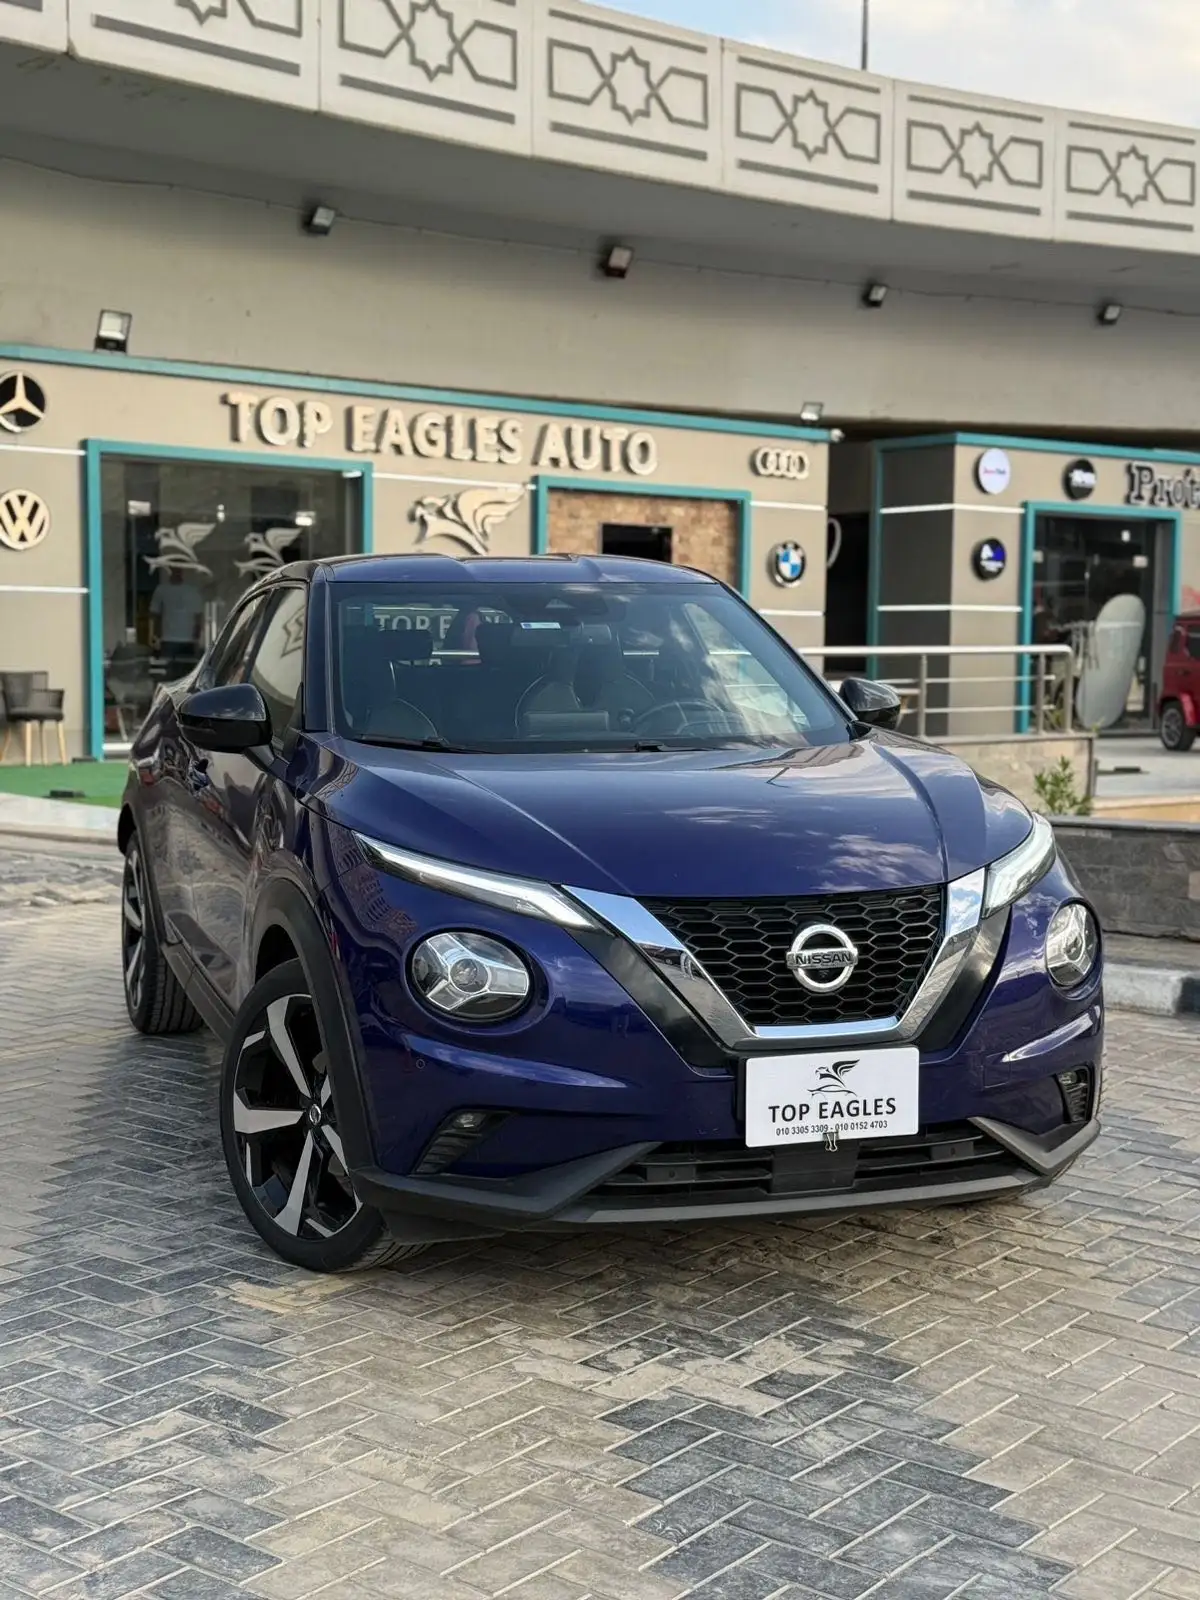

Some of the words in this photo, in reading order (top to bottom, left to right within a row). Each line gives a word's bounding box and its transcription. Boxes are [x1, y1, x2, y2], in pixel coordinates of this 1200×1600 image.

[220, 391, 333, 448] TOP
[345, 406, 522, 464] EAGLES
[531, 422, 658, 476] AUTO
[796, 953, 851, 964] NISSAN
[768, 1103, 810, 1123] TOP
[819, 1097, 896, 1119] EAGLES
[776, 1127, 790, 1136] 010
[791, 1126, 809, 1135] 3305
[810, 1124, 829, 1133] 3309
[850, 1121, 868, 1130] 0152
[870, 1120, 888, 1128] 4703
